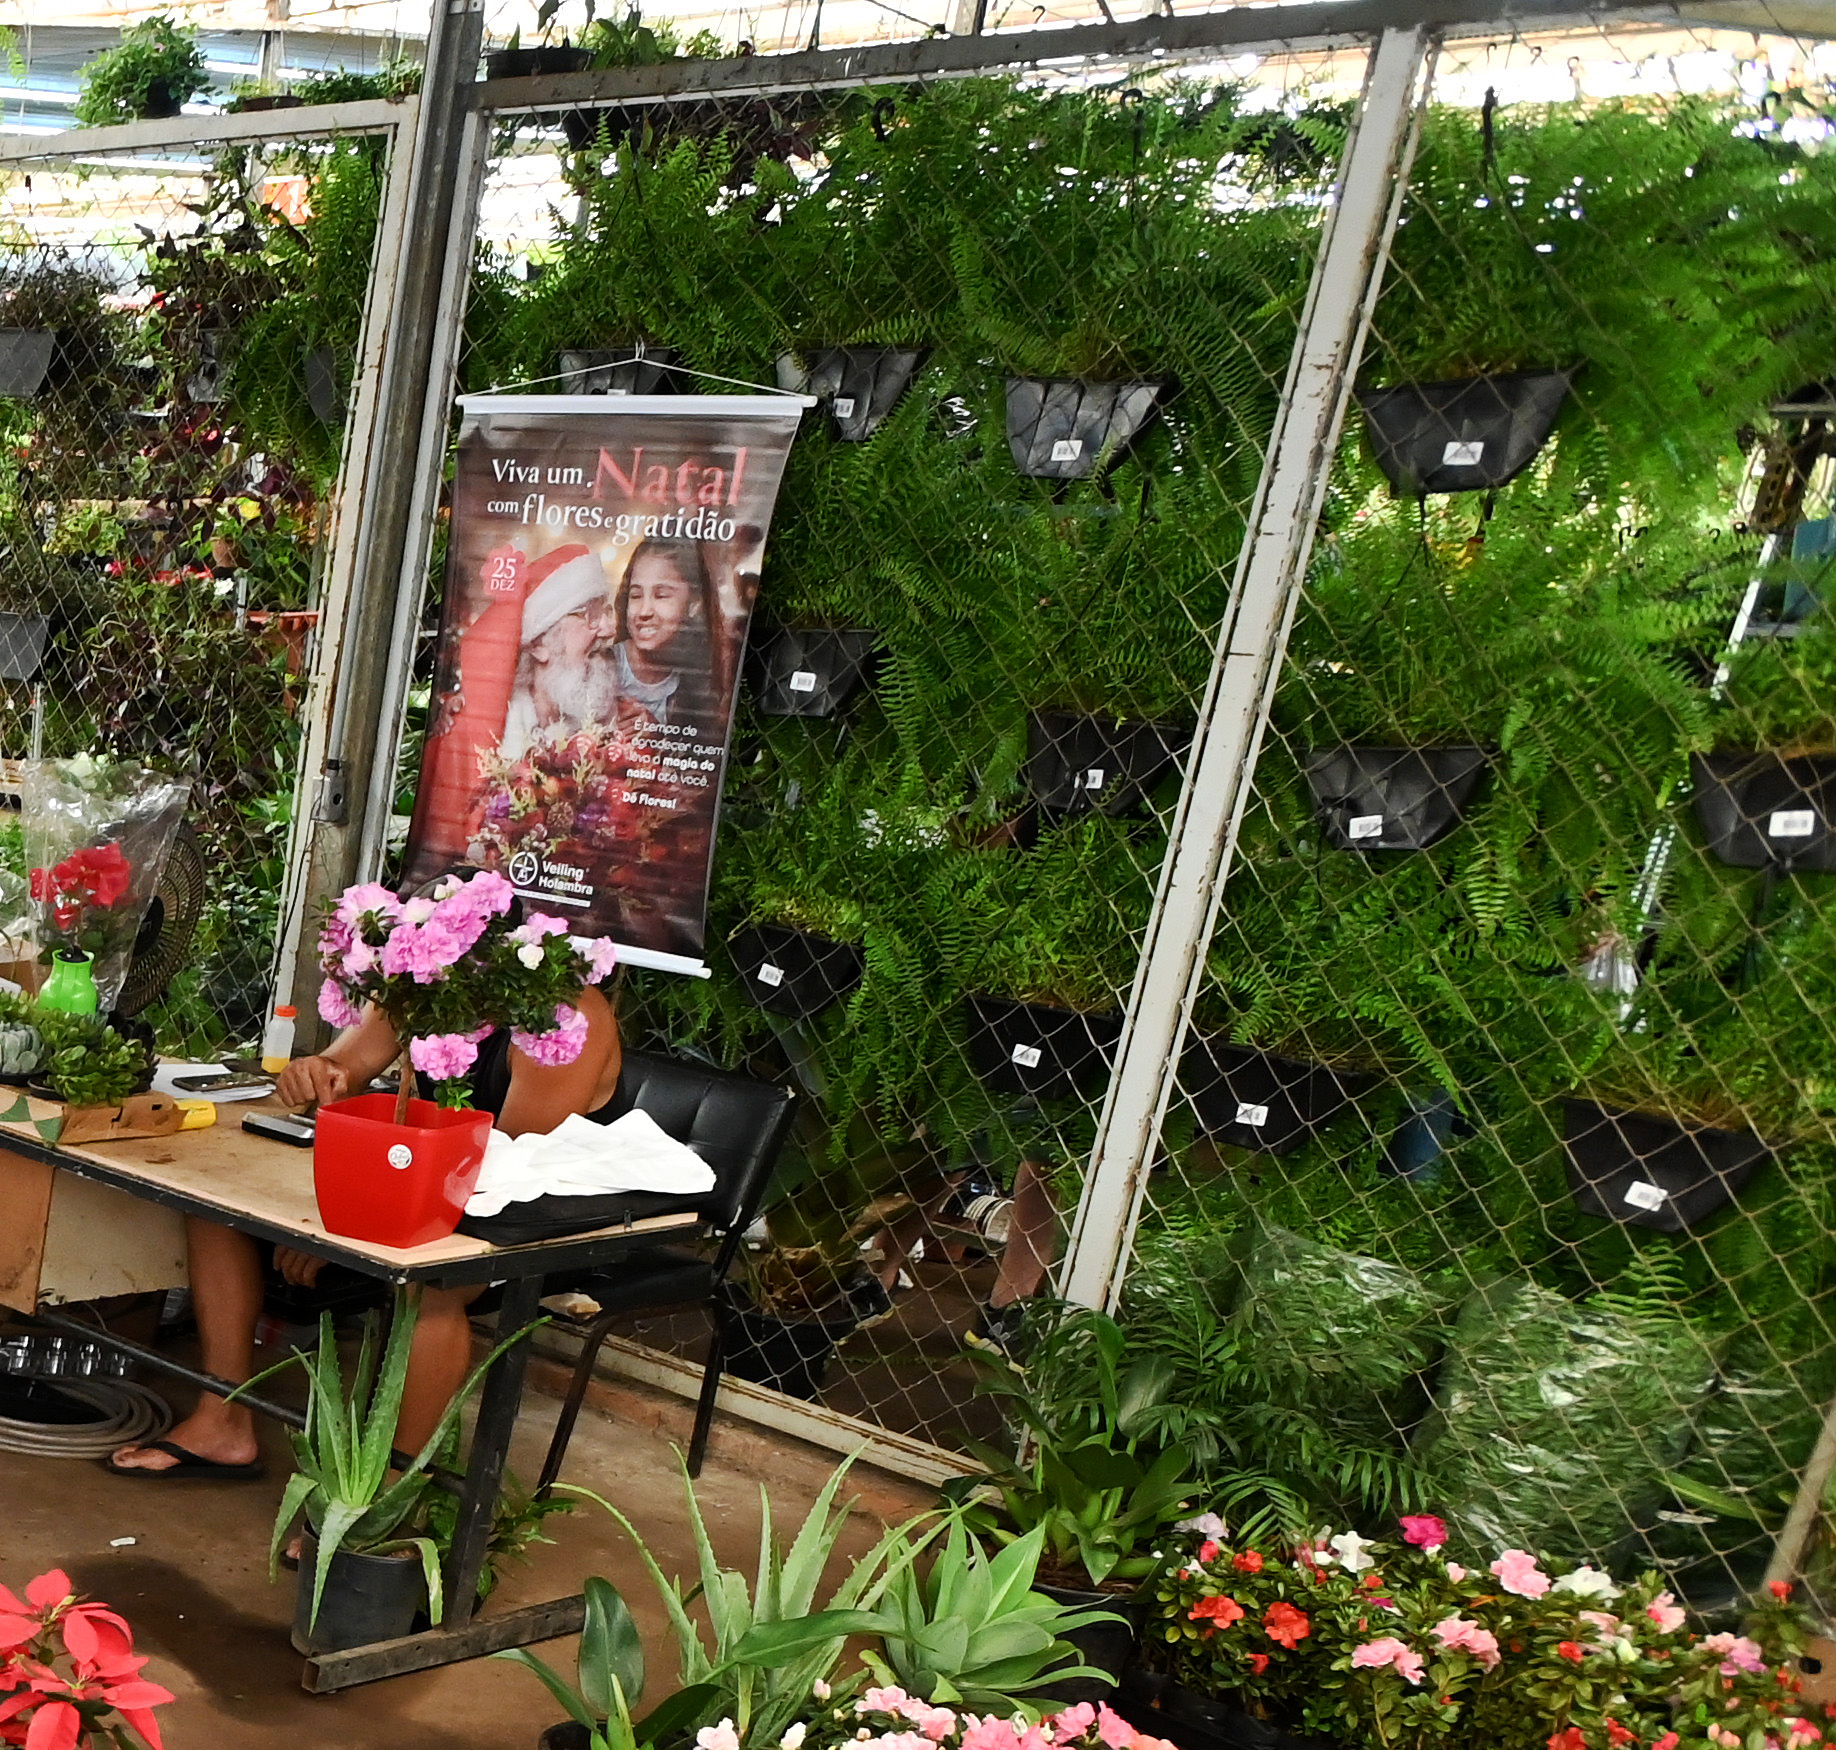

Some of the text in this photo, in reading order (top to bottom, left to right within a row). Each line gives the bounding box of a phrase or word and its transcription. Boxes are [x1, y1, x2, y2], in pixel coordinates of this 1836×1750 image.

[492, 446, 748, 506] Viva um Natal
[487, 494, 736, 546] com flores e gratidão
[490, 557, 517, 592] 25 DEZ
[643, 721, 680, 735] tempo
[682, 725, 698, 737] de
[631, 739, 724, 757] agradecer quem
[652, 755, 661, 765] a
[663, 757, 698, 771] magia
[626, 768, 656, 780] natal
[657, 771, 678, 783] até
[542, 861, 585, 882] Veiling
[538, 875, 594, 896] Holambra
